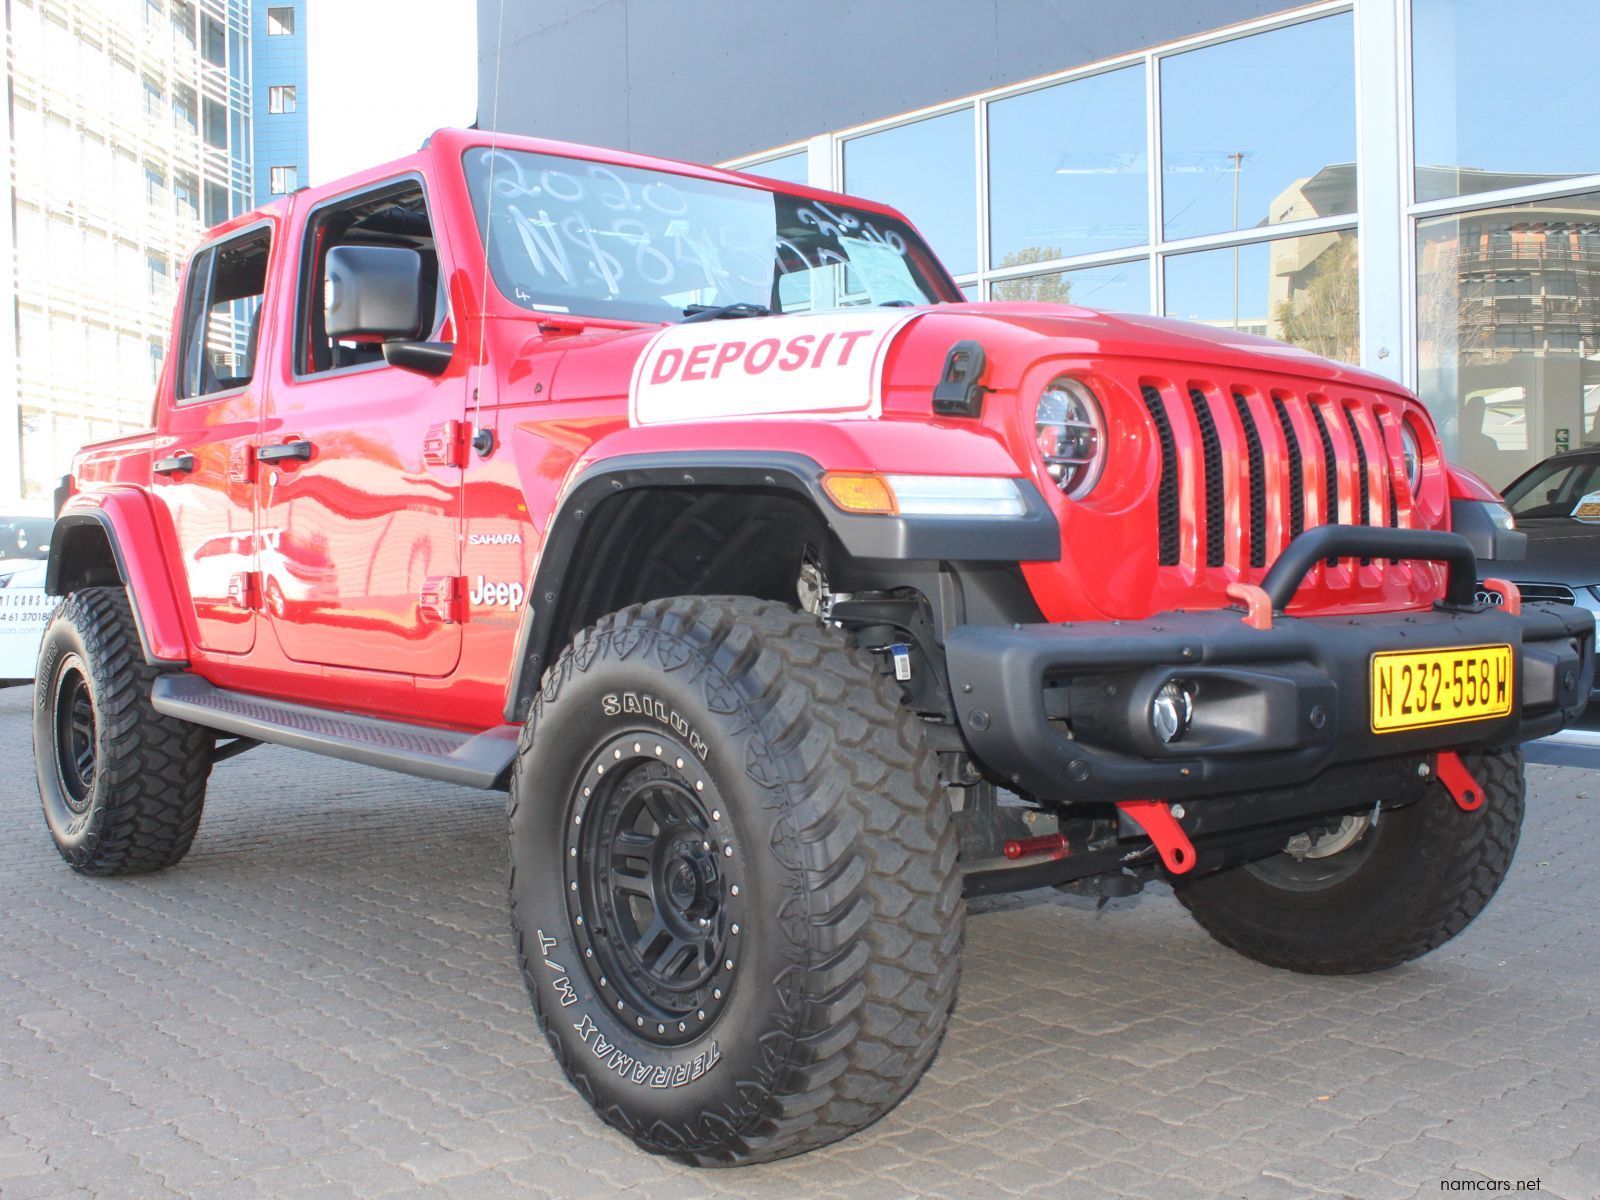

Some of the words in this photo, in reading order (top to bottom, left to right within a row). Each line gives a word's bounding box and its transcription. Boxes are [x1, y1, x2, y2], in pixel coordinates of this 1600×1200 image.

[480, 151, 690, 217] 2020
[650, 329, 874, 385] DEPOSIT
[469, 533, 522, 545] SAHARA
[8, 613, 19, 621] 61
[14, 595, 42, 606] CARS
[469, 575, 524, 612] Jeep
[39, 641, 59, 712] SAILUN
[1380, 665, 1393, 718] N
[1496, 655, 1507, 704] W
[601, 691, 709, 761] SAILUN
[537, 929, 578, 1007] M/T
[573, 1014, 721, 1089] TERRAMAX
